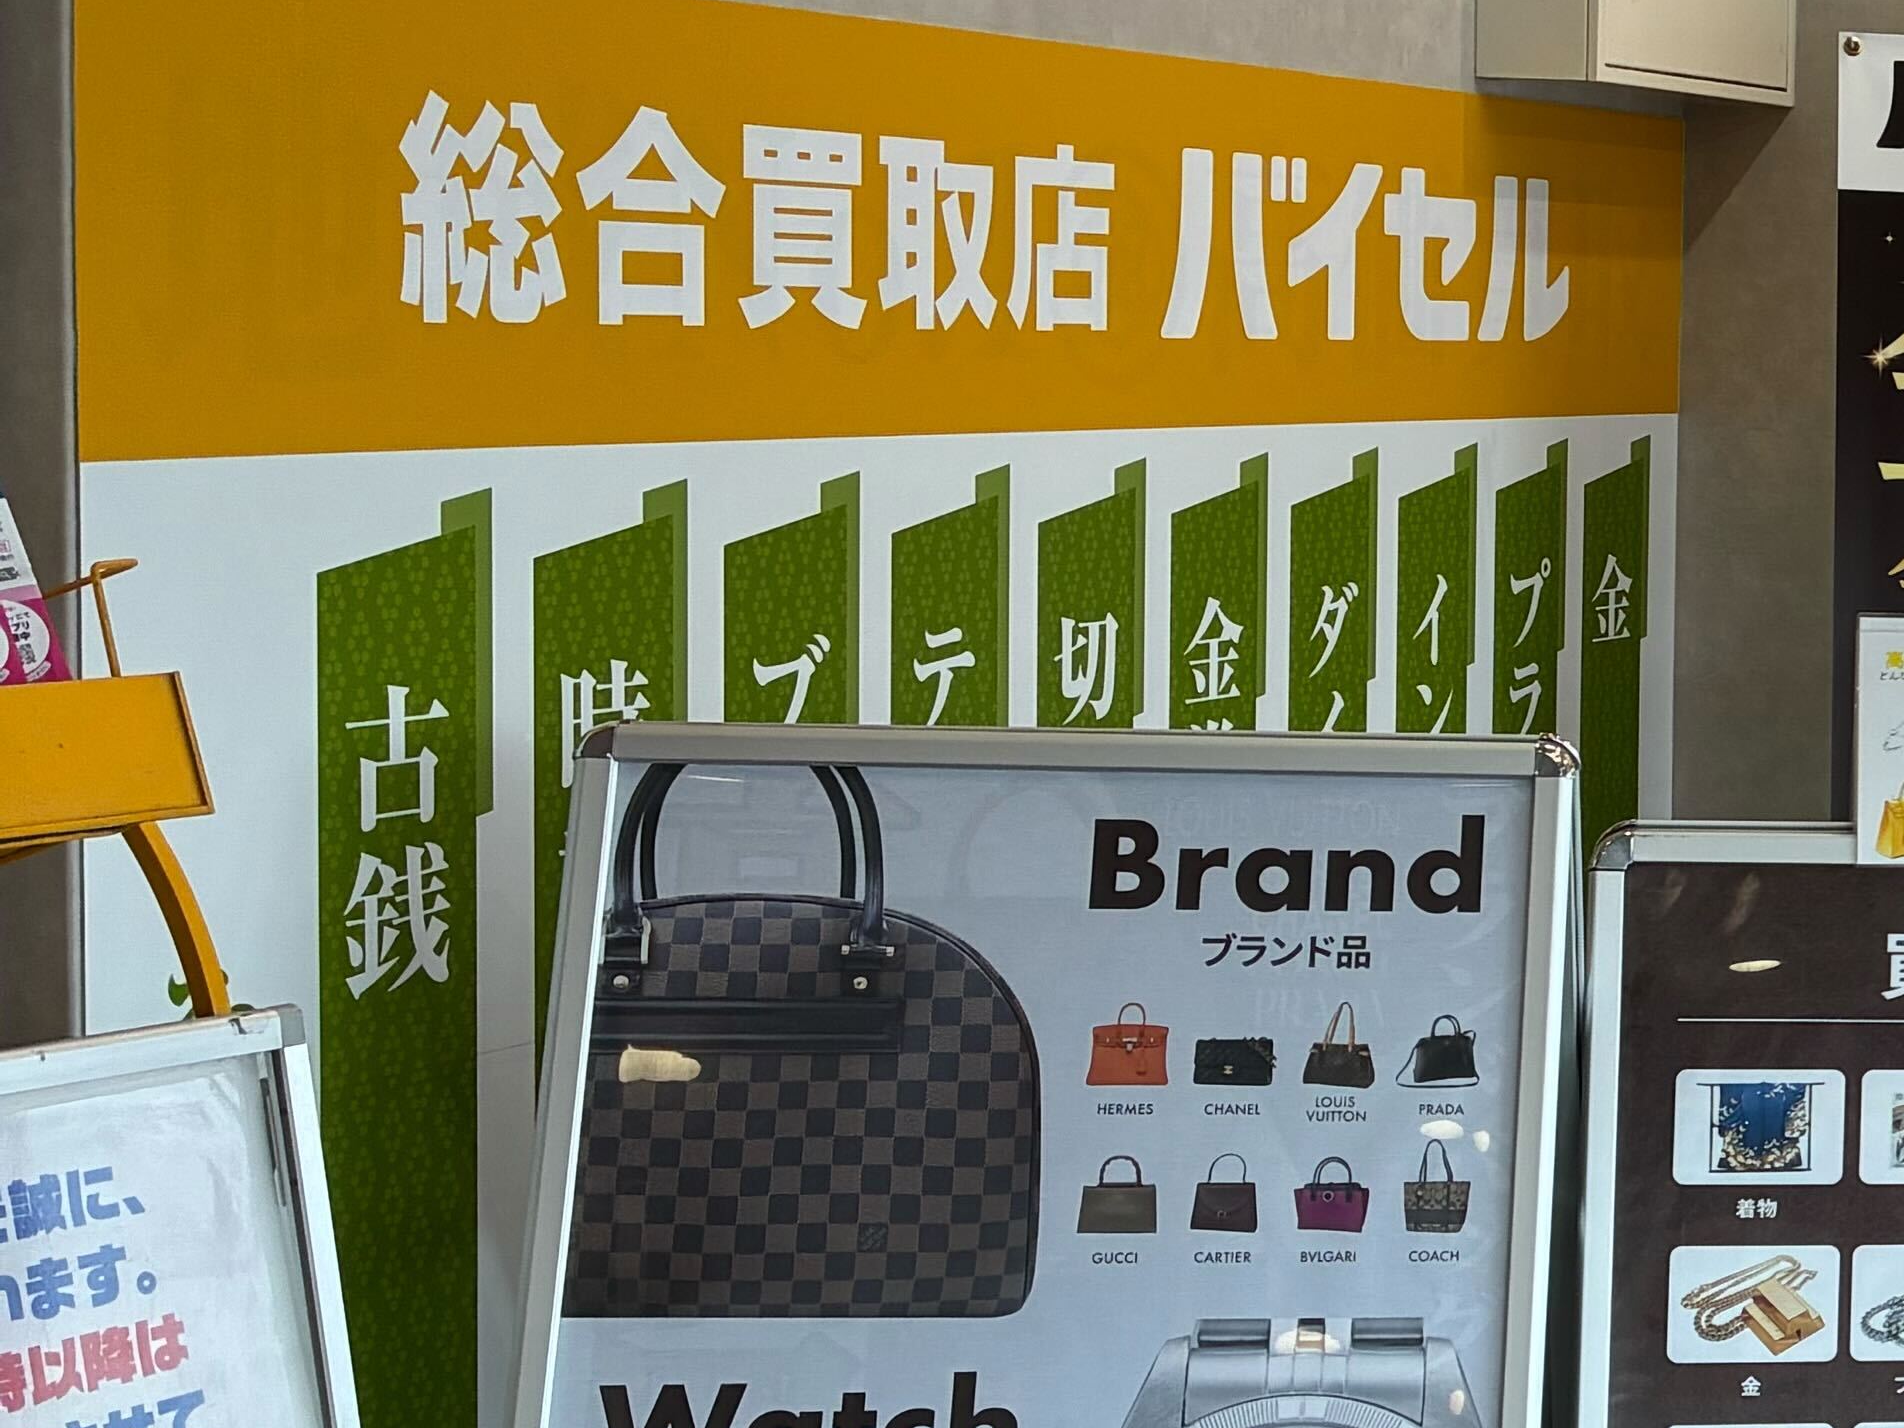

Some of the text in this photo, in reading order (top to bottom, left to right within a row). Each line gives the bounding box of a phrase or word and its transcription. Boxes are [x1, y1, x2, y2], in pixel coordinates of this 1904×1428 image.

[399, 90, 1569, 342] 総合買取店 バイセル
[1591, 554, 1633, 643] 金
[1053, 612, 1119, 725] 切
[343, 684, 450, 1000] 古銭
[1088, 814, 1485, 913] Brand
[1201, 933, 1371, 969] ブランド品
[1097, 1103, 1154, 1116] HERMES
[1204, 1103, 1261, 1116] CHANEL
[1315, 1096, 1356, 1109] LOUIS
[1418, 1102, 1465, 1116] PRADA
[1306, 1109, 1367, 1123] VUITTON
[0, 1166, 145, 1243] 誠に、
[1736, 1197, 1778, 1219] 着物
[1091, 1252, 1138, 1265] GUCCI
[1193, 1251, 1251, 1264] CARTIER
[1300, 1250, 1357, 1263] BVLGARI
[1408, 1249, 1460, 1263] COACH
[1740, 1376, 1761, 1398] 金
